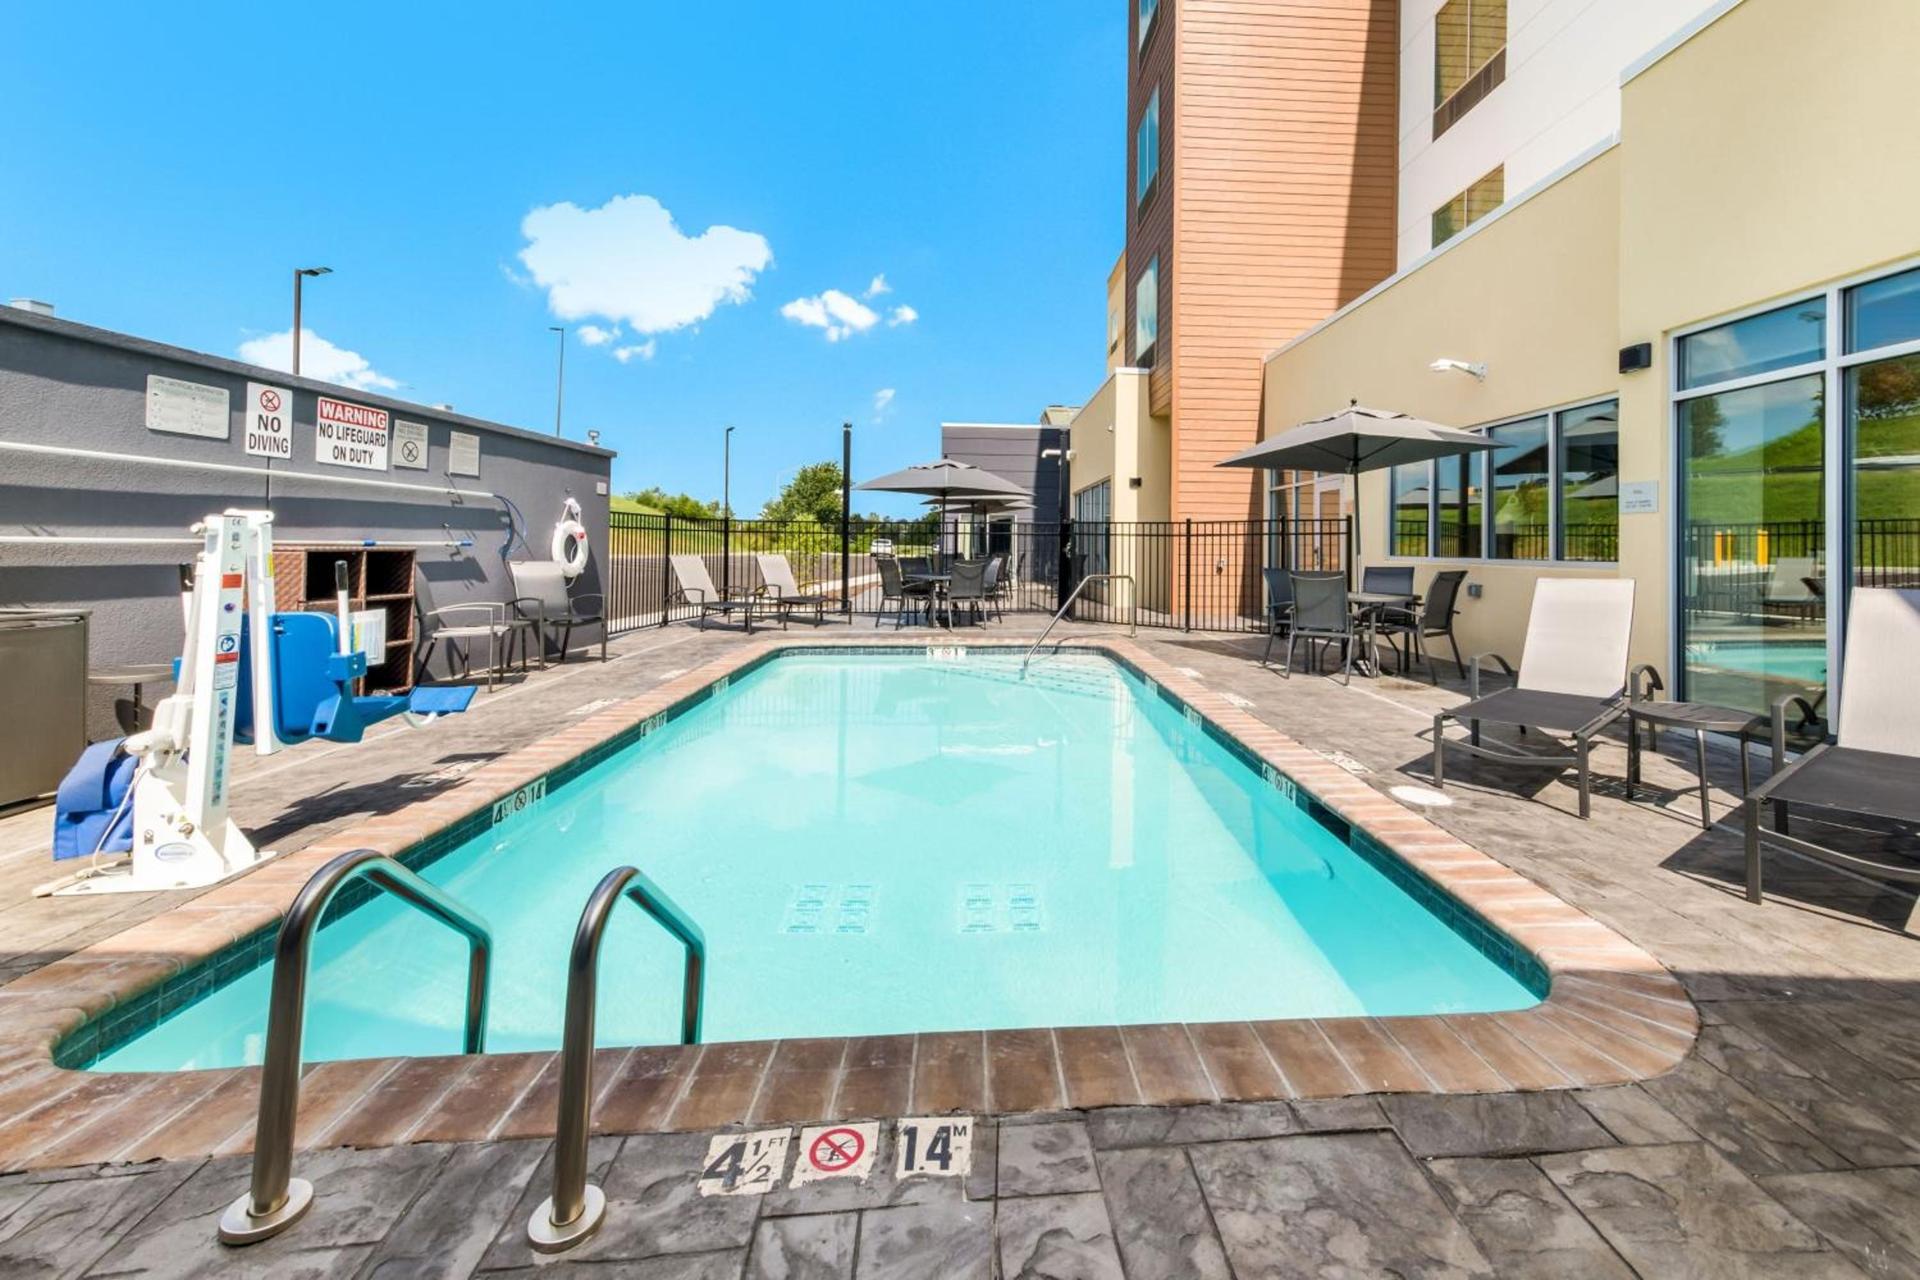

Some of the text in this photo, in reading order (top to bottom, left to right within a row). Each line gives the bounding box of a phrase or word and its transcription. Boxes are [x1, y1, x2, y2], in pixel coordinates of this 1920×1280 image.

[258, 414, 281, 433] NO
[321, 401, 386, 428] WARNING
[249, 433, 288, 454] DIVING
[320, 422, 333, 438] NO
[336, 425, 386, 447] LIFEGUARD
[333, 445, 374, 464] ON DUTY
[953, 1125, 967, 1137] M
[768, 1136, 787, 1148] FT
